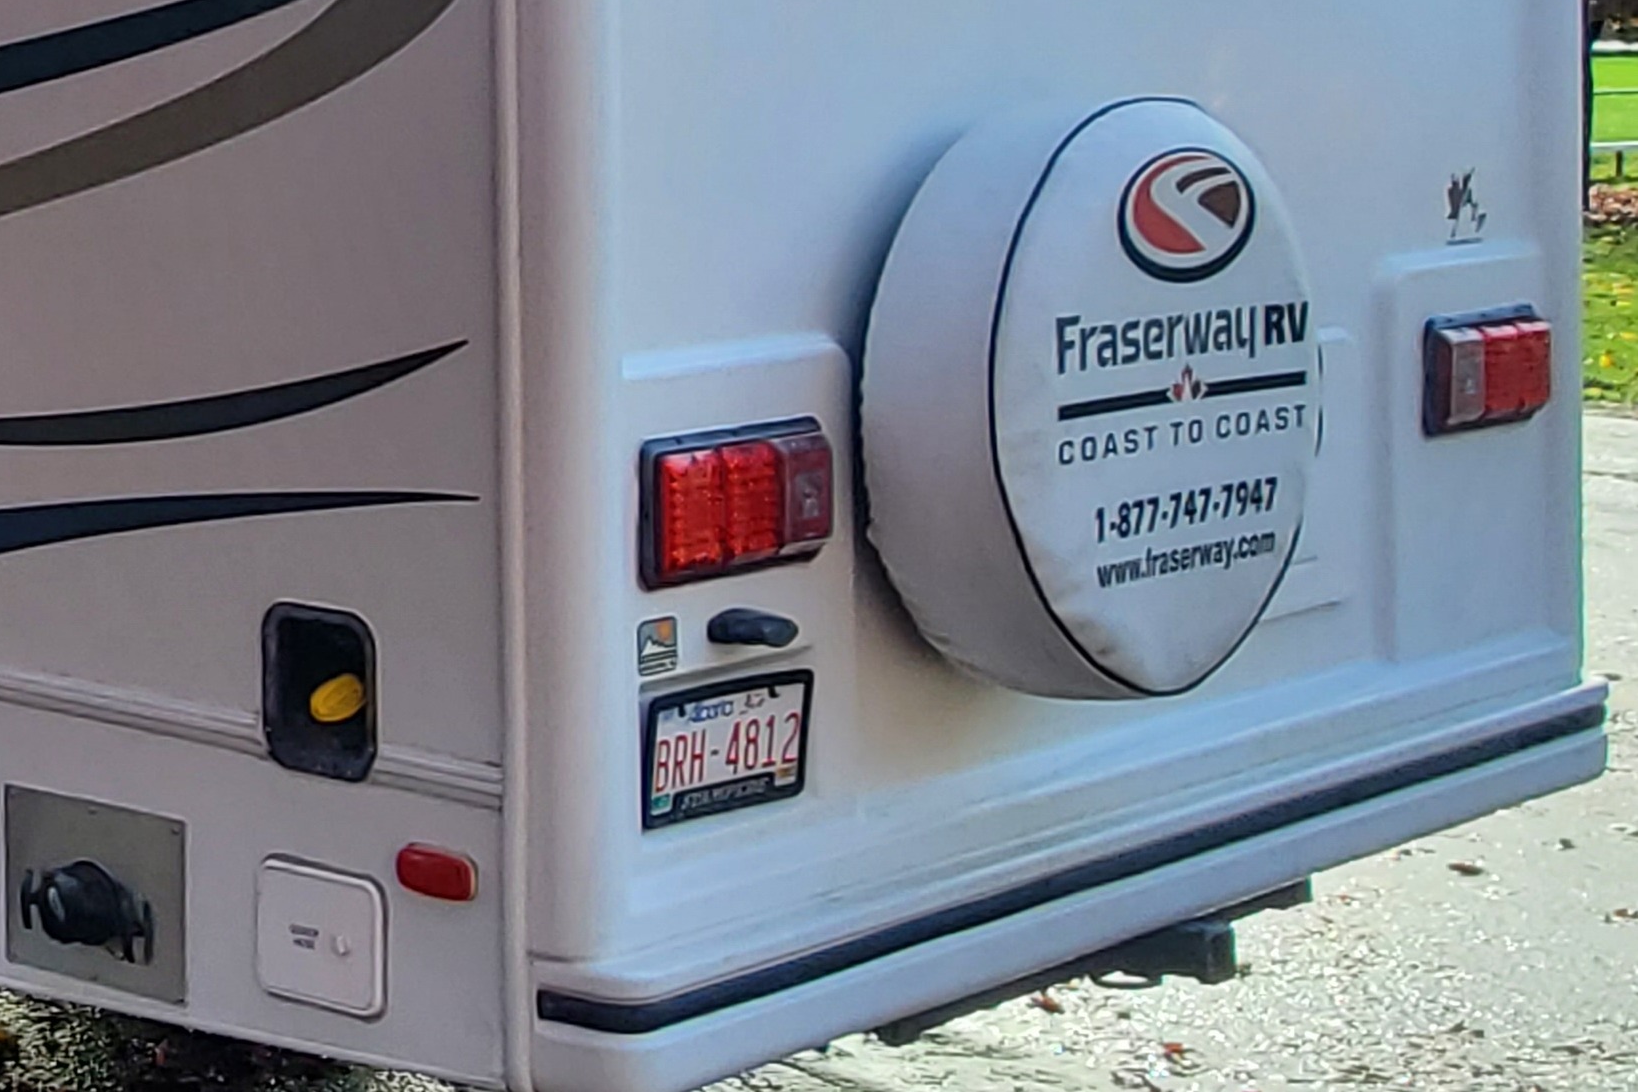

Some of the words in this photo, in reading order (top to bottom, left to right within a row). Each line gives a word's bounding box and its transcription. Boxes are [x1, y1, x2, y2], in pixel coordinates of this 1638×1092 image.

[1055, 305, 1257, 376] Fraserway
[1264, 301, 1309, 346] RV
[1058, 426, 1158, 465] COAST
[1170, 419, 1204, 446] TO
[1216, 404, 1307, 439] COAST
[1095, 476, 1278, 544] 1-877-747-7947
[1096, 531, 1276, 588] www.fraserway.com
